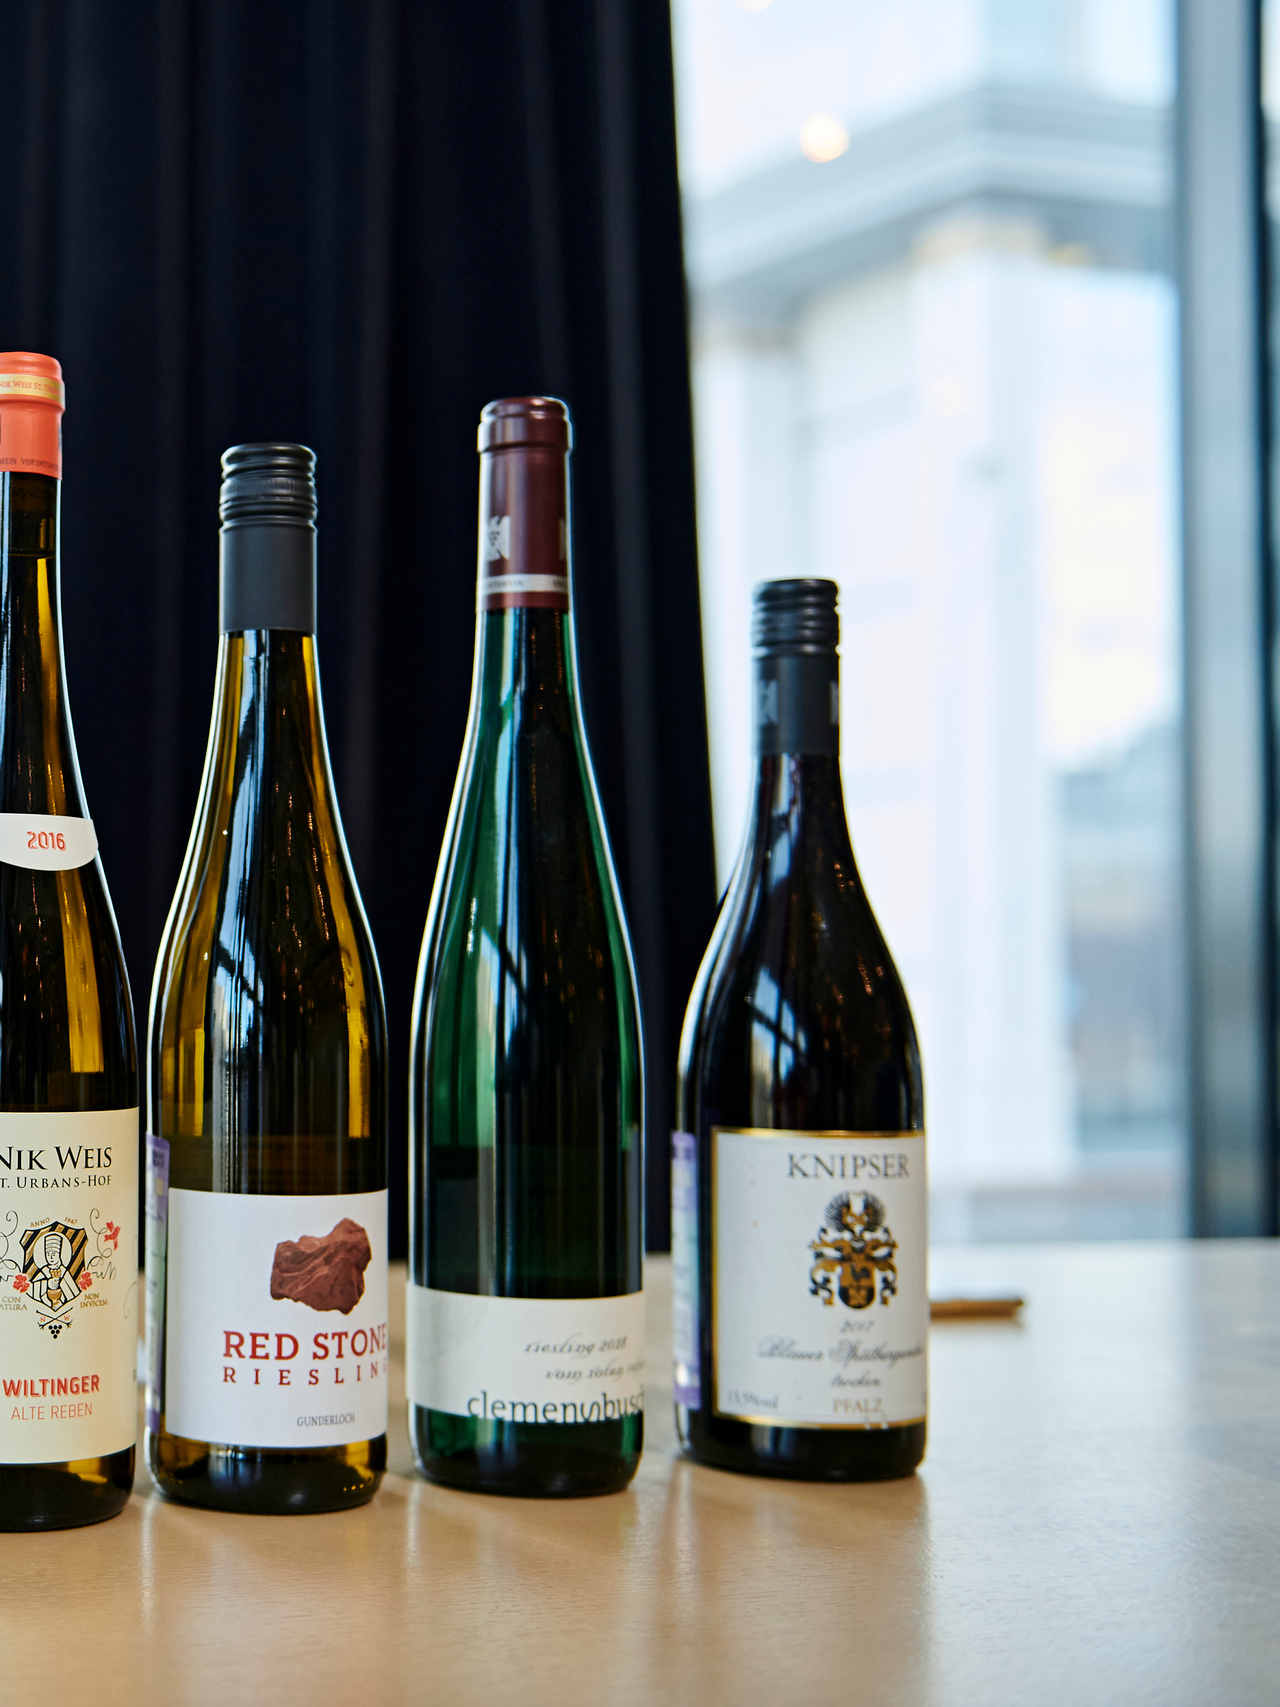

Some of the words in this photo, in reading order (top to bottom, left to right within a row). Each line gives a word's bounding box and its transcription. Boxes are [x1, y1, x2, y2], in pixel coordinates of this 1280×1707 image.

[13, 380, 31, 389] WEIS
[26, 831, 67, 852] 2016
[787, 1153, 910, 1178] KNIPSER
[30, 1217, 51, 1228] ANNO
[64, 1216, 78, 1225] 1947
[80, 1299, 108, 1309] INVICEM
[84, 1293, 100, 1301] NON
[840, 1320, 874, 1334] 2017
[223, 1330, 299, 1360] RED
[312, 1322, 387, 1360] STONE
[546, 1370, 582, 1385] vom
[2, 1374, 100, 1398] WILTINGER
[11, 1406, 45, 1421] ALTE
[51, 1402, 93, 1420] REBEN
[833, 1397, 883, 1414] PFALZ
[297, 1413, 355, 1427] GUNDERLOCH
